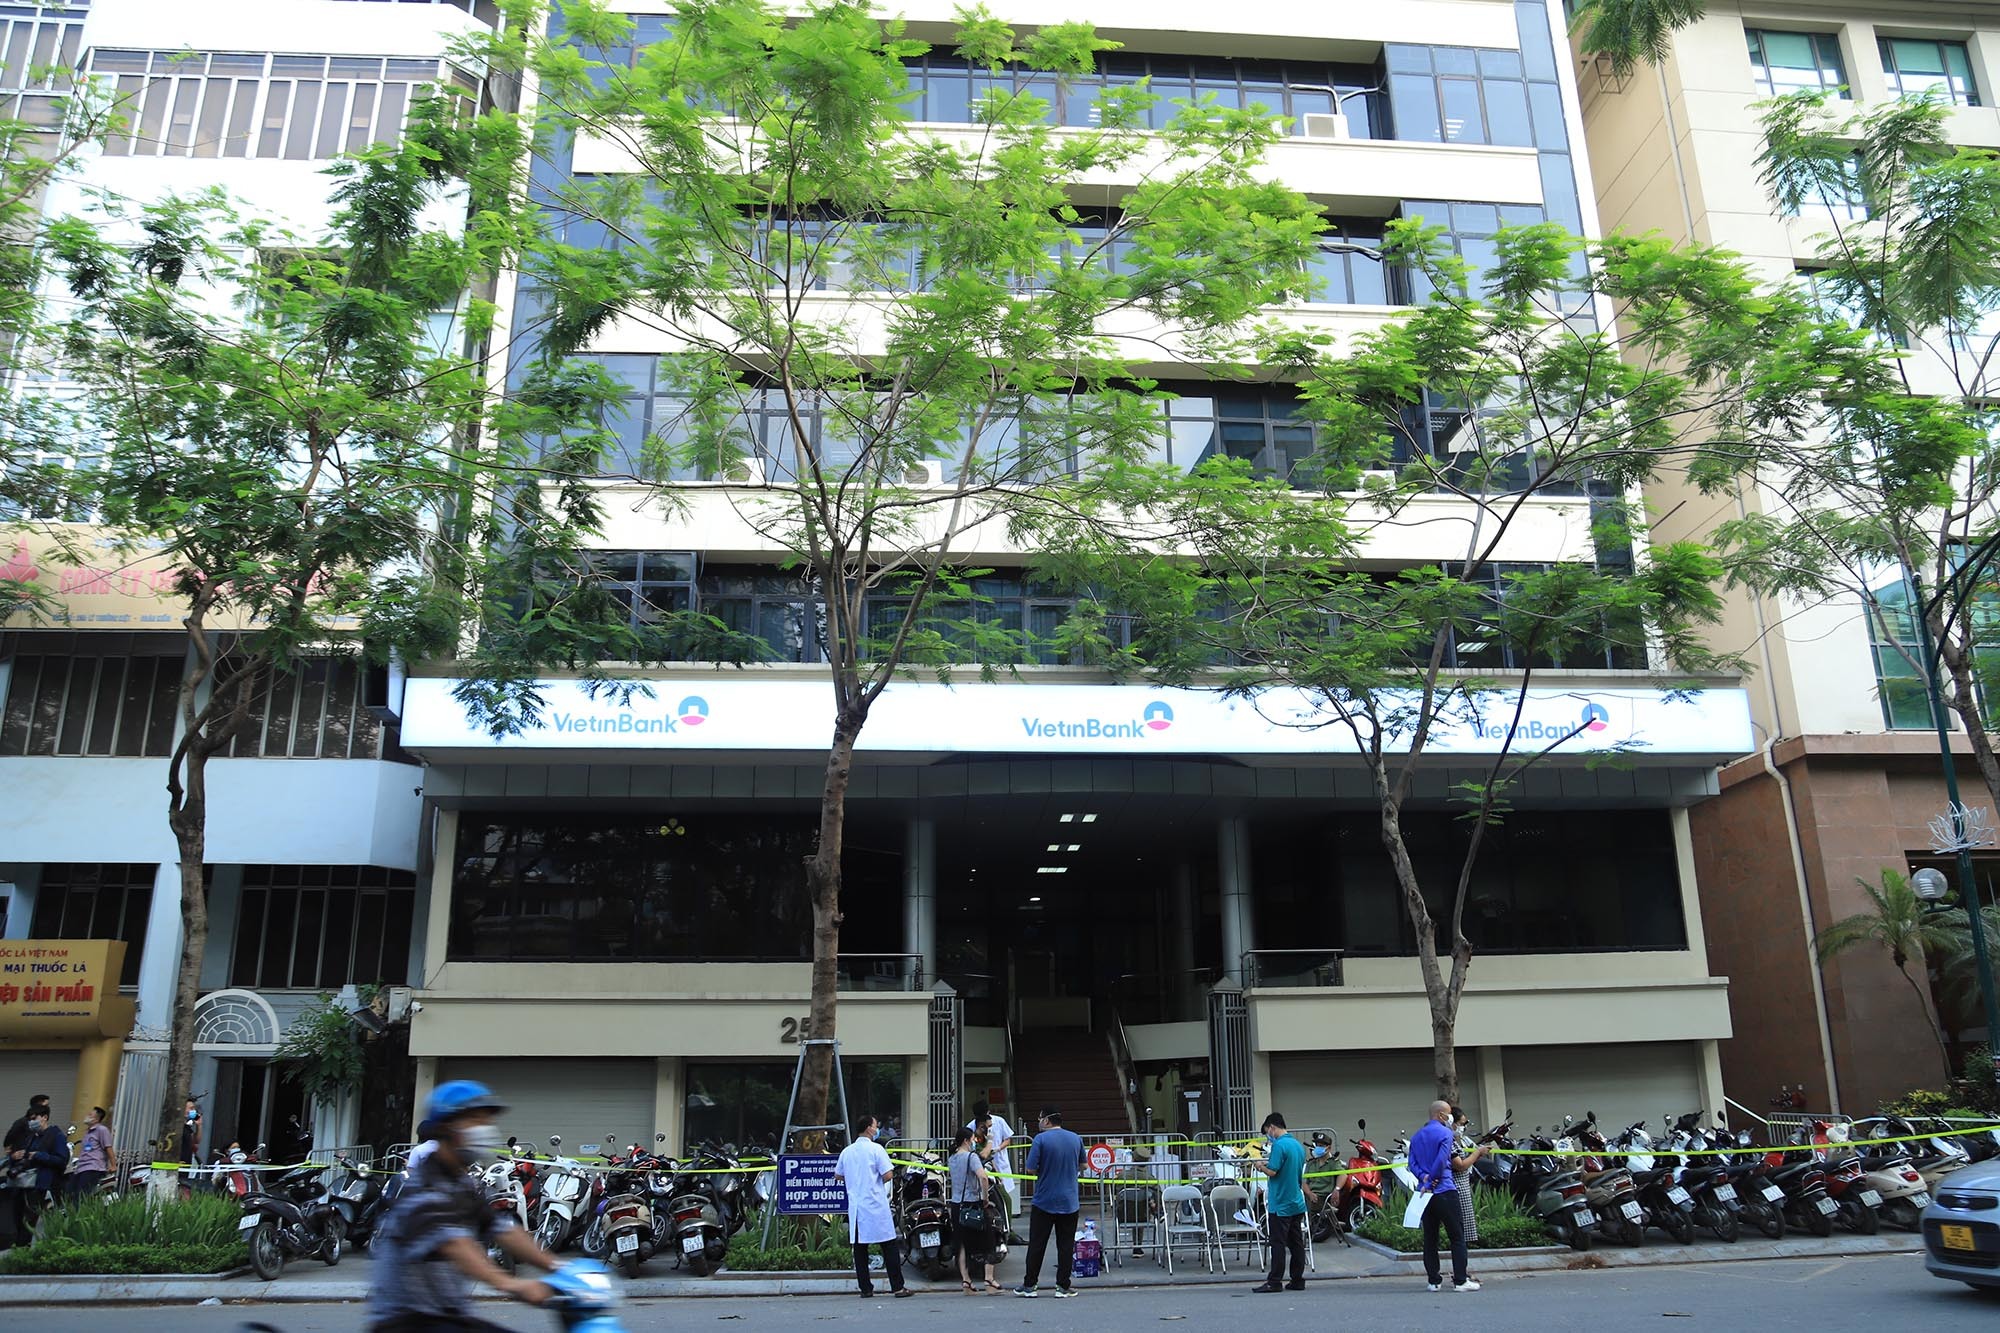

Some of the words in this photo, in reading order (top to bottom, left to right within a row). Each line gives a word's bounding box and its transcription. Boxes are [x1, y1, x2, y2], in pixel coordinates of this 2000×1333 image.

[553, 712, 678, 733] VietinBank
[1021, 717, 1145, 738] VietinBank
[1469, 719, 1585, 739] VietnBank
[29, 948, 47, 958] VIỆT
[48, 949, 68, 957] NAM
[4, 963, 26, 974] MẠI
[31, 960, 67, 973] THUỐC
[23, 980, 52, 1002] SẢN
[785, 1160, 799, 1174] P
[785, 1191, 809, 1203] HỢP
[812, 1188, 845, 1200] ĐỒNG
